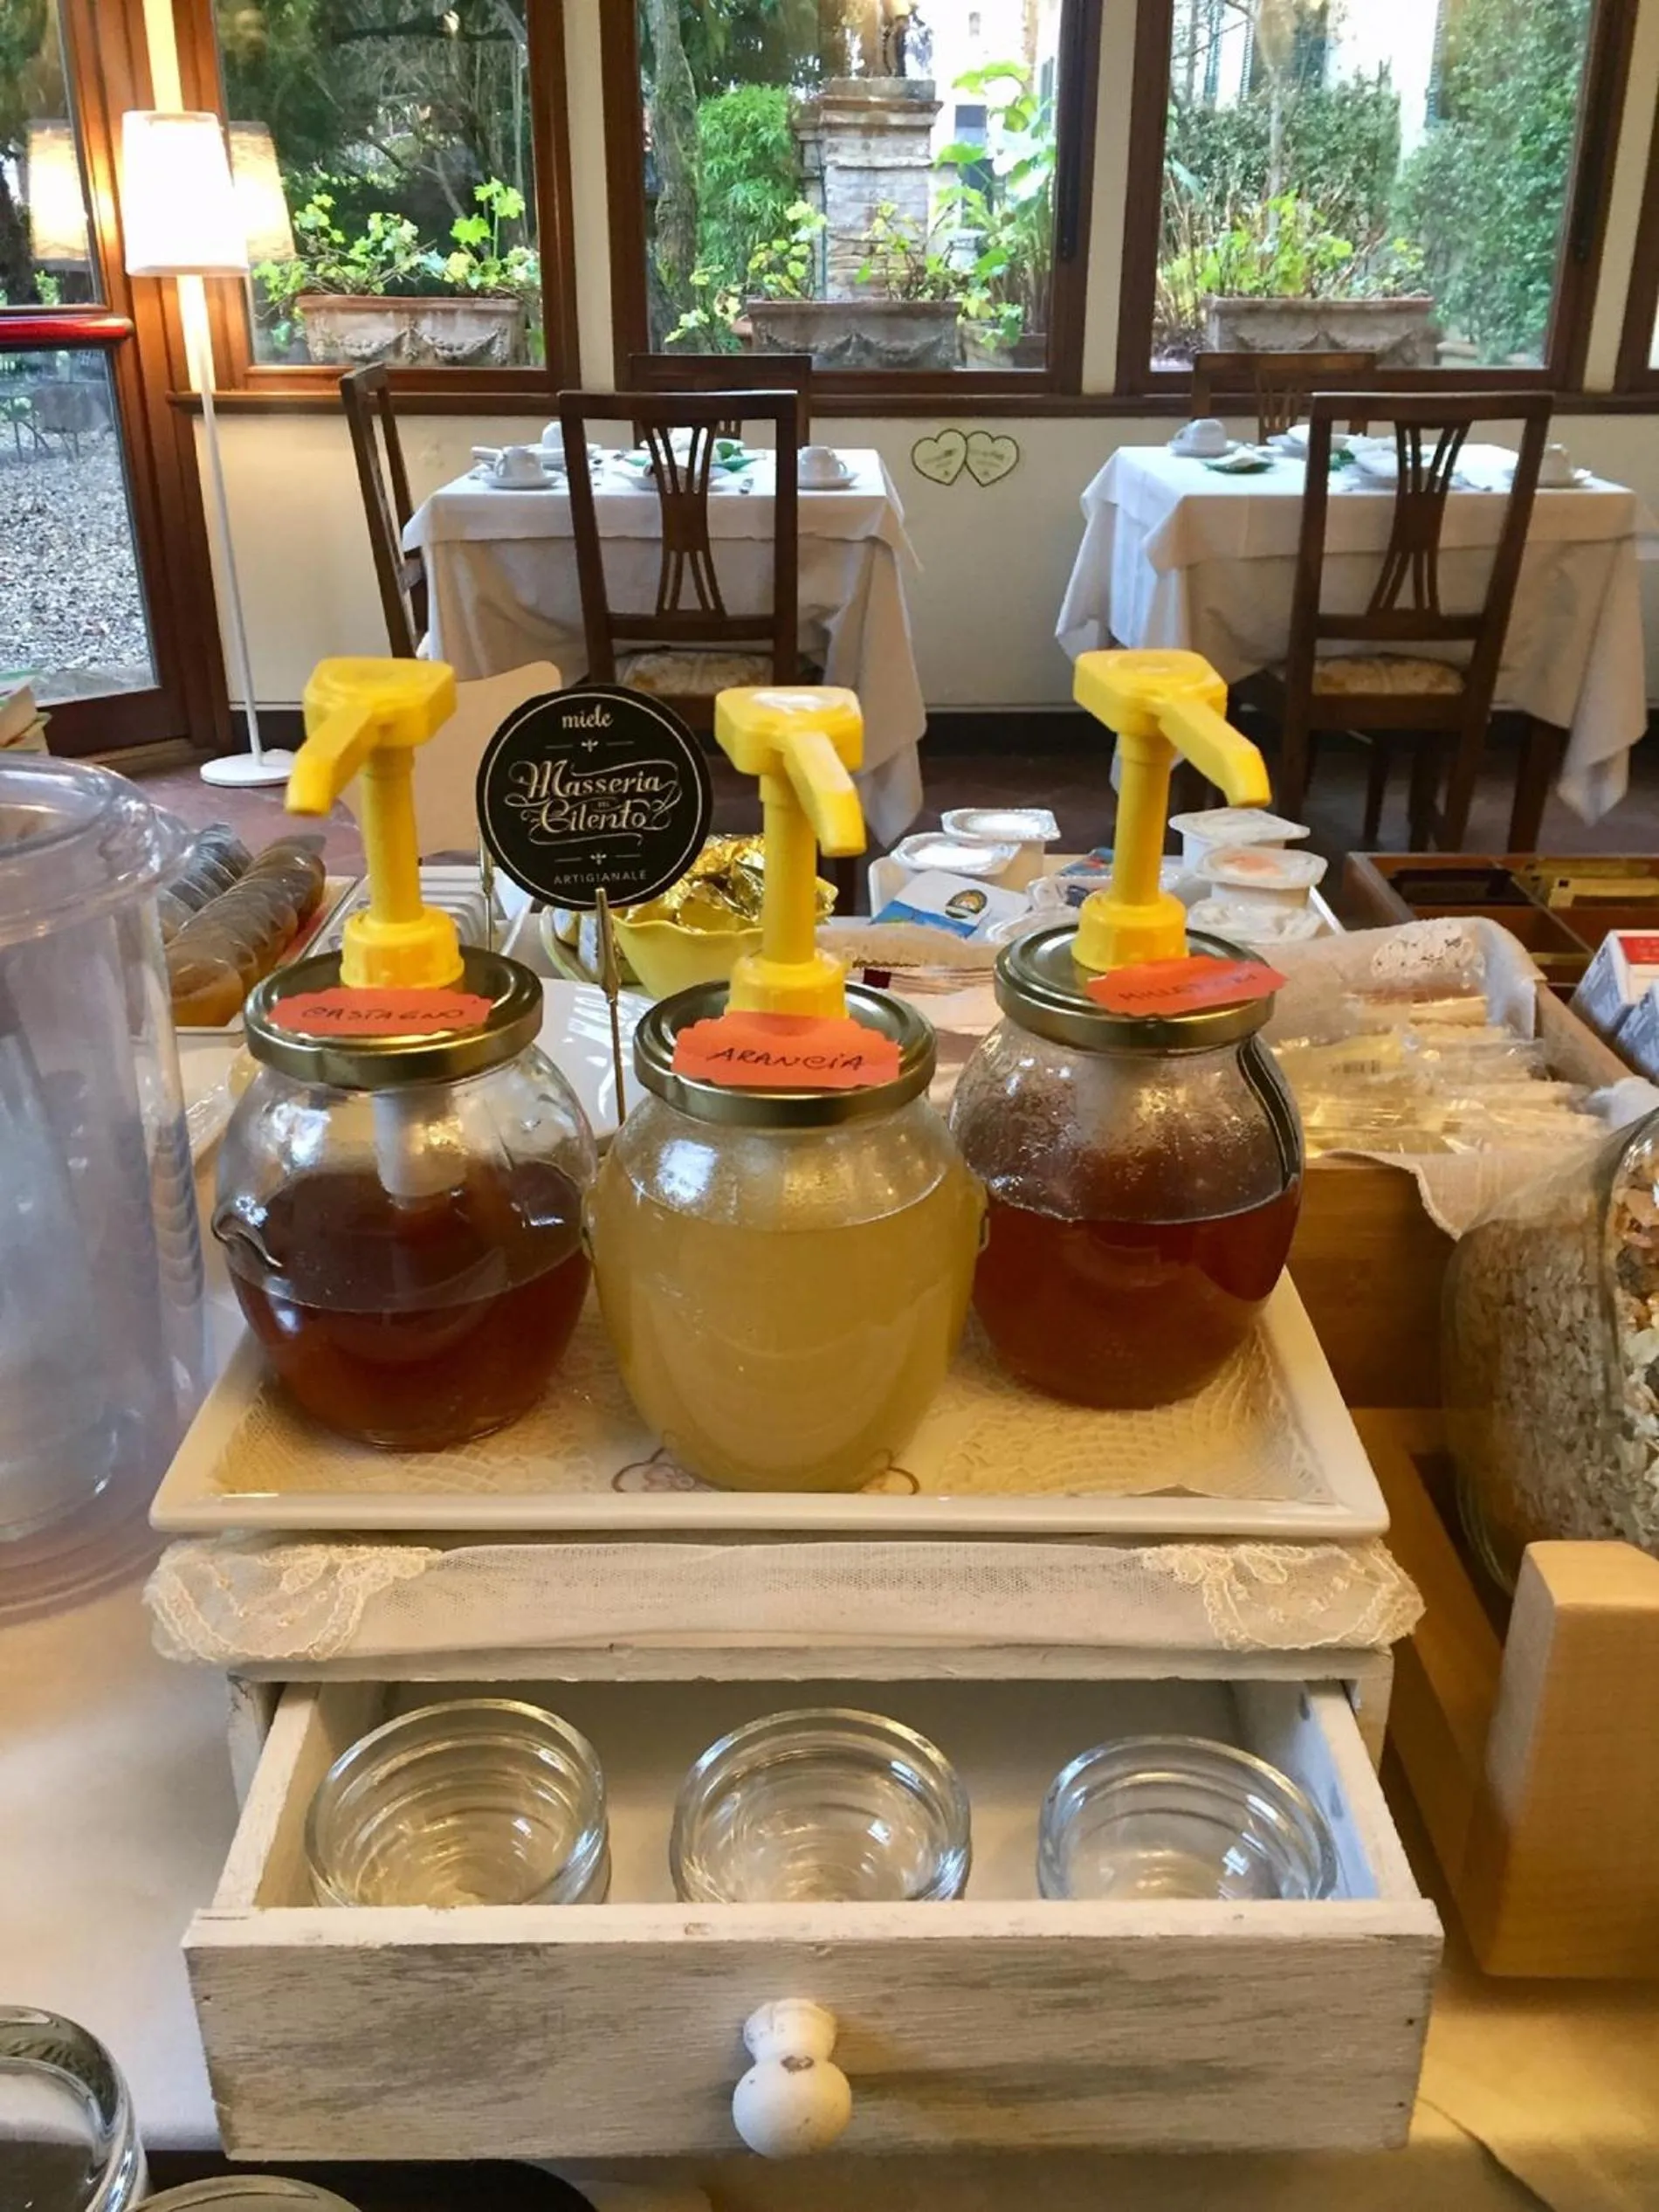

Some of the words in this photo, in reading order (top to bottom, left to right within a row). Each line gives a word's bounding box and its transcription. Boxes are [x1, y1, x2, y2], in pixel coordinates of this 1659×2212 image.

[561, 703, 614, 728] miele
[510, 759, 662, 798] Masseria
[534, 797, 648, 833] Cilento
[554, 869, 648, 885] ARTIGIANALE
